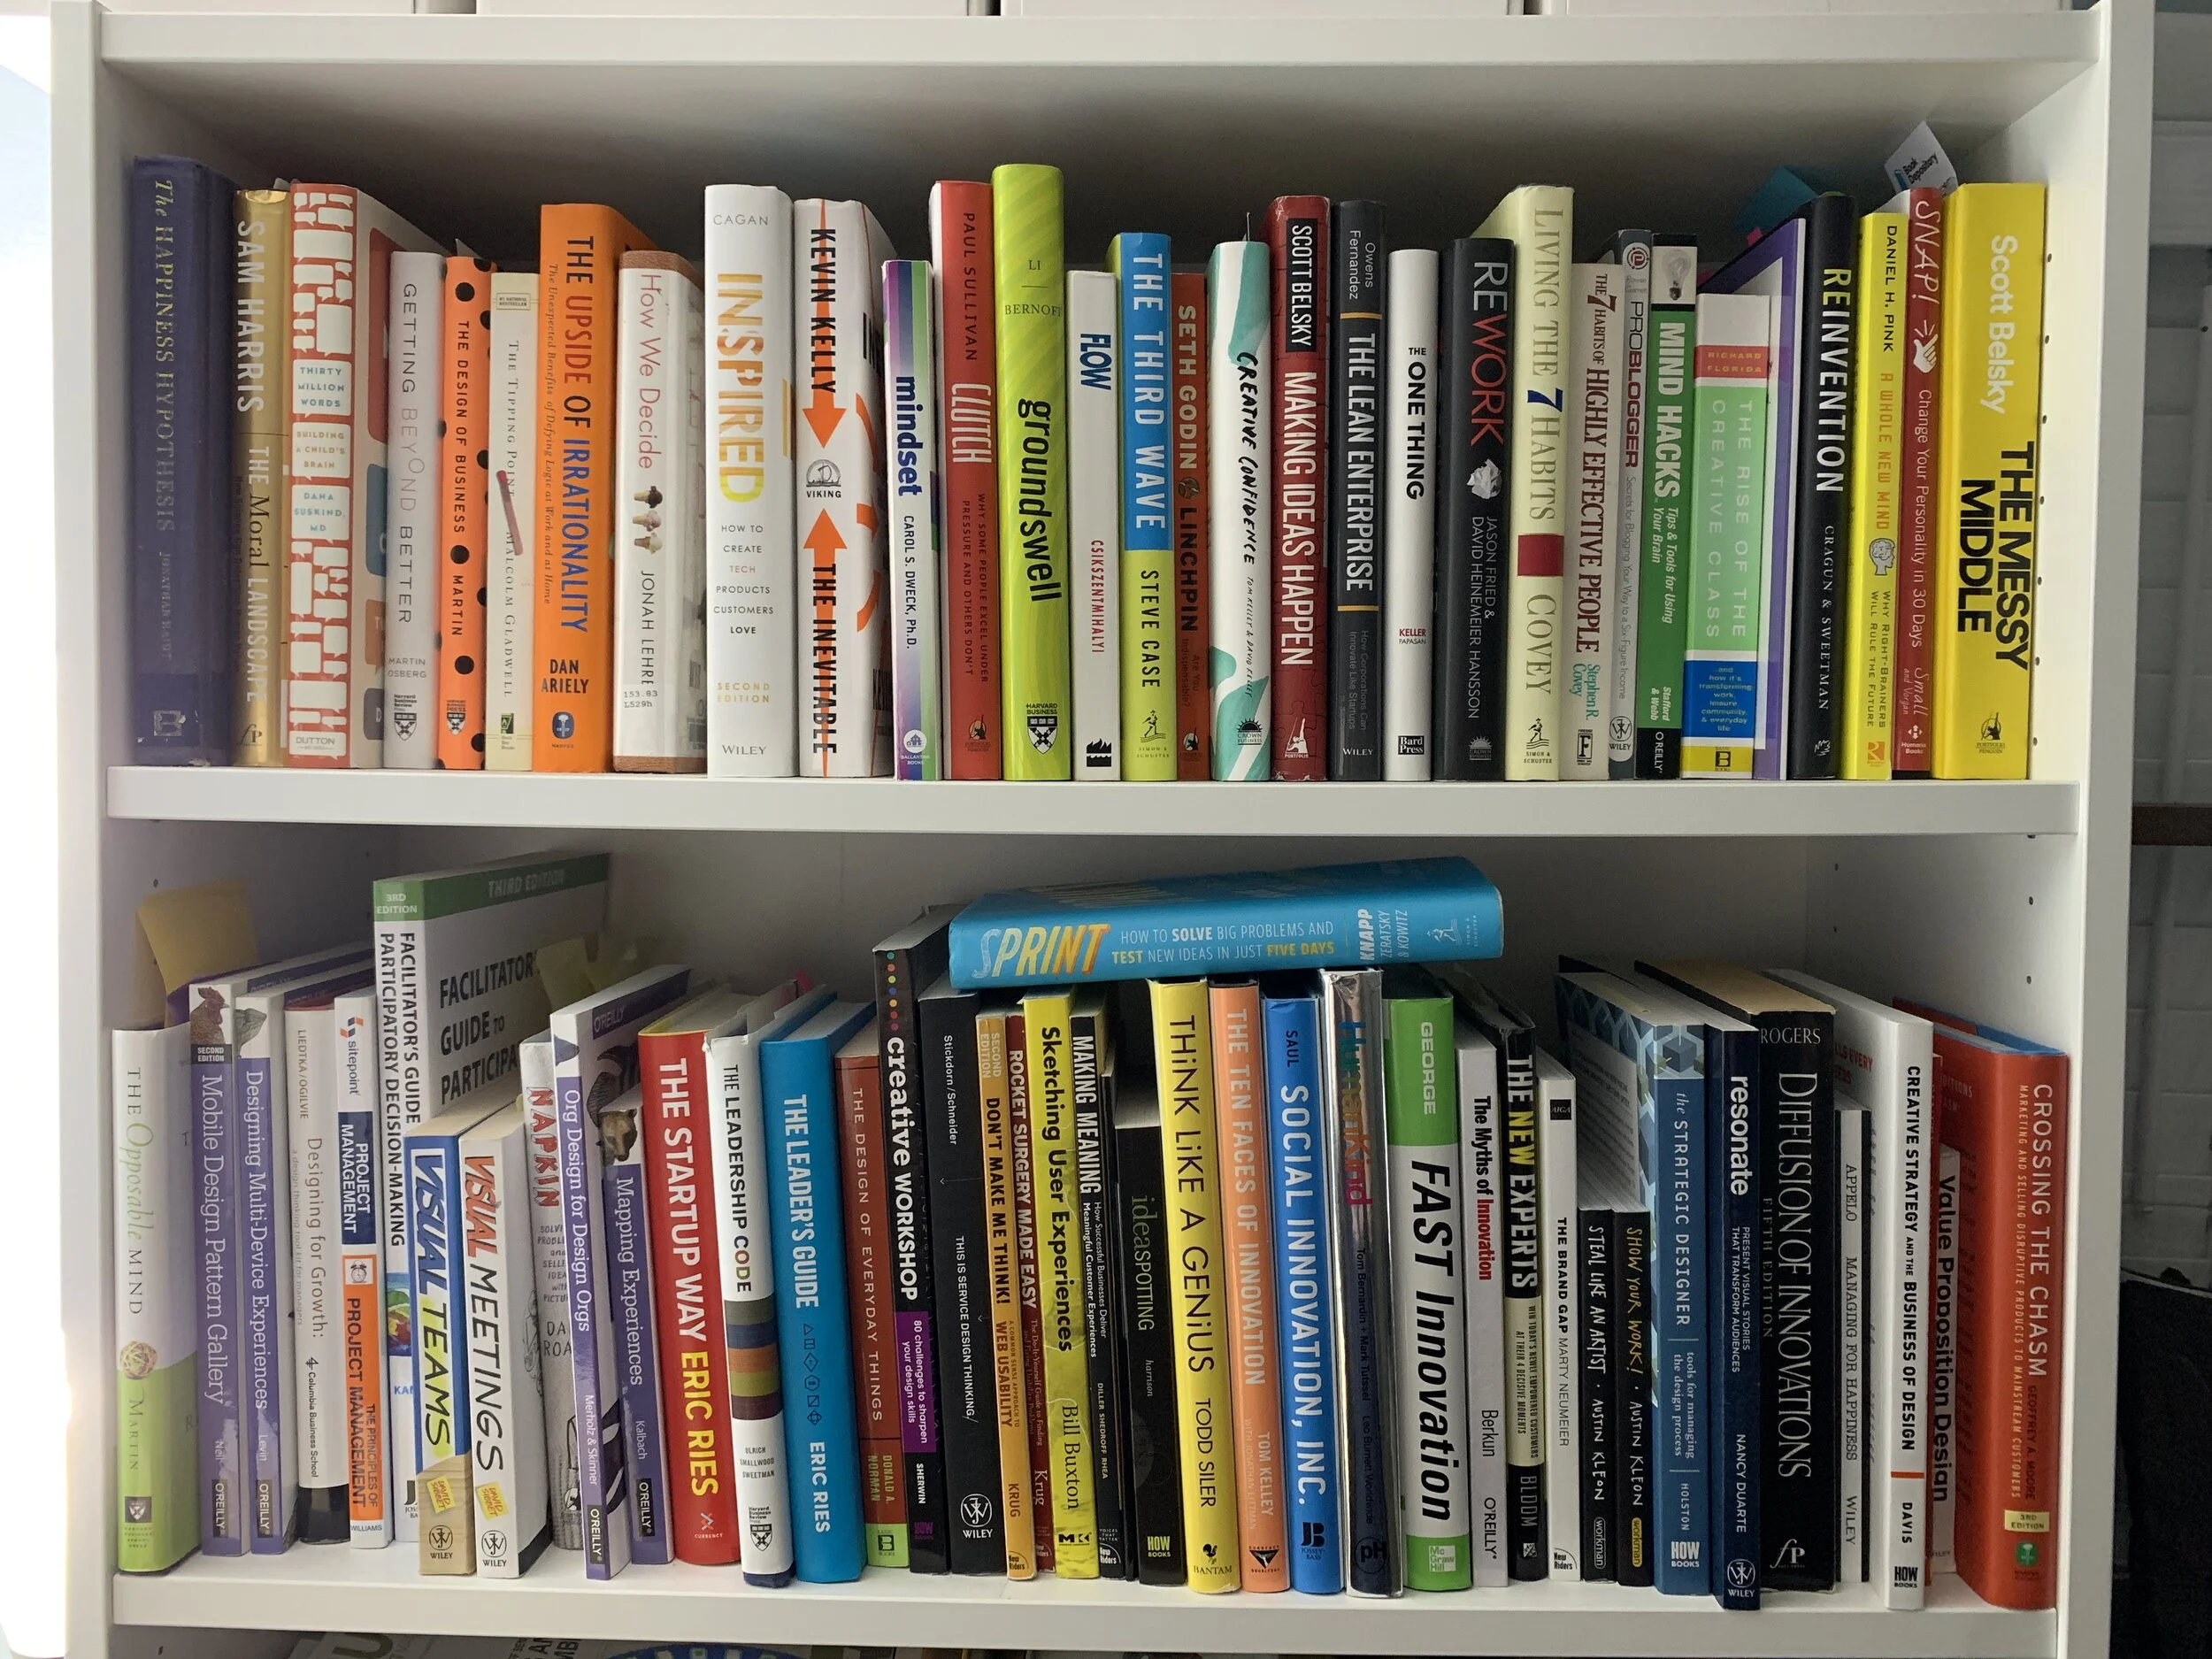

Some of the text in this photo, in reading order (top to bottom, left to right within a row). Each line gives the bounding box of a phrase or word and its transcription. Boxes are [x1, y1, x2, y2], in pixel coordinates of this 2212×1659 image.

[713, 214, 769, 226] CAGAN
[1029, 261, 1041, 270] LI
[1349, 230, 1361, 300] Fernandez
[1364, 242, 1375, 288] Owens
[1911, 201, 1939, 303] SNAP!
[237, 221, 265, 411] SAM HARRIS
[810, 229, 836, 393] KEVIN KELLY
[964, 212, 977, 360] PAUL SULLIVAN
[1292, 225, 1312, 346] SCOTT BELSKY
[1884, 226, 1897, 352] DANIEL H. PINK
[1980, 234, 2018, 414] Scott Belsky
[298, 383, 344, 392] MILLION
[638, 275, 662, 468] How We Decide
[717, 273, 764, 503] INSPIRED
[1080, 334, 1111, 390] FLOW
[1133, 254, 1165, 529] THE THIRD WAVE
[1409, 347, 1426, 356] THE
[1471, 262, 1508, 446] REWORK
[1624, 302, 1643, 468] PROBLOGGER
[1654, 323, 1686, 497] MIND HACKS
[1816, 269, 1852, 492] REINVENTION
[562, 236, 594, 632] THE UPSIDE OF IRRATIONALITY
[896, 376, 924, 496] mindset
[951, 383, 992, 463] CLUTCH
[1347, 334, 1375, 591] THE LEAN ENTERPRISE
[1407, 362, 1425, 499] ONE THING
[1018, 398, 1062, 602] groundswell
[1280, 373, 1317, 664] MAKING IDEAS HAPPEN
[1957, 480, 1995, 633] MIDDLE
[1996, 442, 2034, 670] THE MESSY
[1091, 540, 1104, 652] CSIKSZENTMIHALYI
[1141, 571, 1160, 687] STEVE CASE
[541, 679, 589, 694] ARIELY
[549, 659, 579, 673] DAN
[812, 564, 837, 754] THE INEVITABLE
[722, 745, 766, 755] WILEY
[1400, 736, 1423, 745] Bard
[1400, 744, 1424, 754] Press
[972, 923, 1110, 979] SPRINT
[1112, 941, 1335, 964] TEST NEW IDEAS IN JUST FIVE DAYS
[1120, 920, 1334, 944] HOW TO SOLVE BIG PROBLEMS AND
[348, 1041, 360, 1095] sitepoint
[1420, 1022, 1438, 1115] GEORGE
[1761, 1028, 1821, 1044] ROGERS
[723, 1064, 751, 1292] THE LEADERSHIP CODE
[1041, 1027, 1073, 1352] Sketching User Experiences
[1731, 1076, 1753, 1195] resonate
[201, 1075, 228, 1405] Mobile Design Pattern Gallery
[617, 1179, 642, 1386] Mapping Experiences
[659, 1058, 719, 1496] THE STARTUP WAY ERIC RIES
[894, 1171, 918, 1301] WORKSHOP
[1778, 1073, 1818, 1478] DIFFUSION OF INNOVATIONS
[2029, 1085, 2054, 1375] CROSSING THE CHASM
[415, 1156, 450, 1446] VISUAL TEAMS
[465, 1156, 503, 1471] VISUAL MEETINGS
[1280, 1085, 1325, 1504] SOCIAL INNOVATION, INC.
[1411, 1161, 1459, 1521] FAST Innovation
[741, 1471, 775, 1479] SWEETMAN
[917, 1463, 926, 1504] SHERWIN
[1481, 1410, 1499, 1456] Berkun
[1736, 1434, 1747, 1532] NANCY DUARTE
[963, 1529, 993, 1539] WILEY
[1148, 1536, 1171, 1550] HOW
[1193, 1565, 1232, 1574] BANTAM
[1671, 1542, 1700, 1559] HOW
[1894, 1566, 1918, 1582] HOW
[1901, 1502, 1913, 1543] DAVIS
[1728, 1589, 1755, 1598] WILEY
